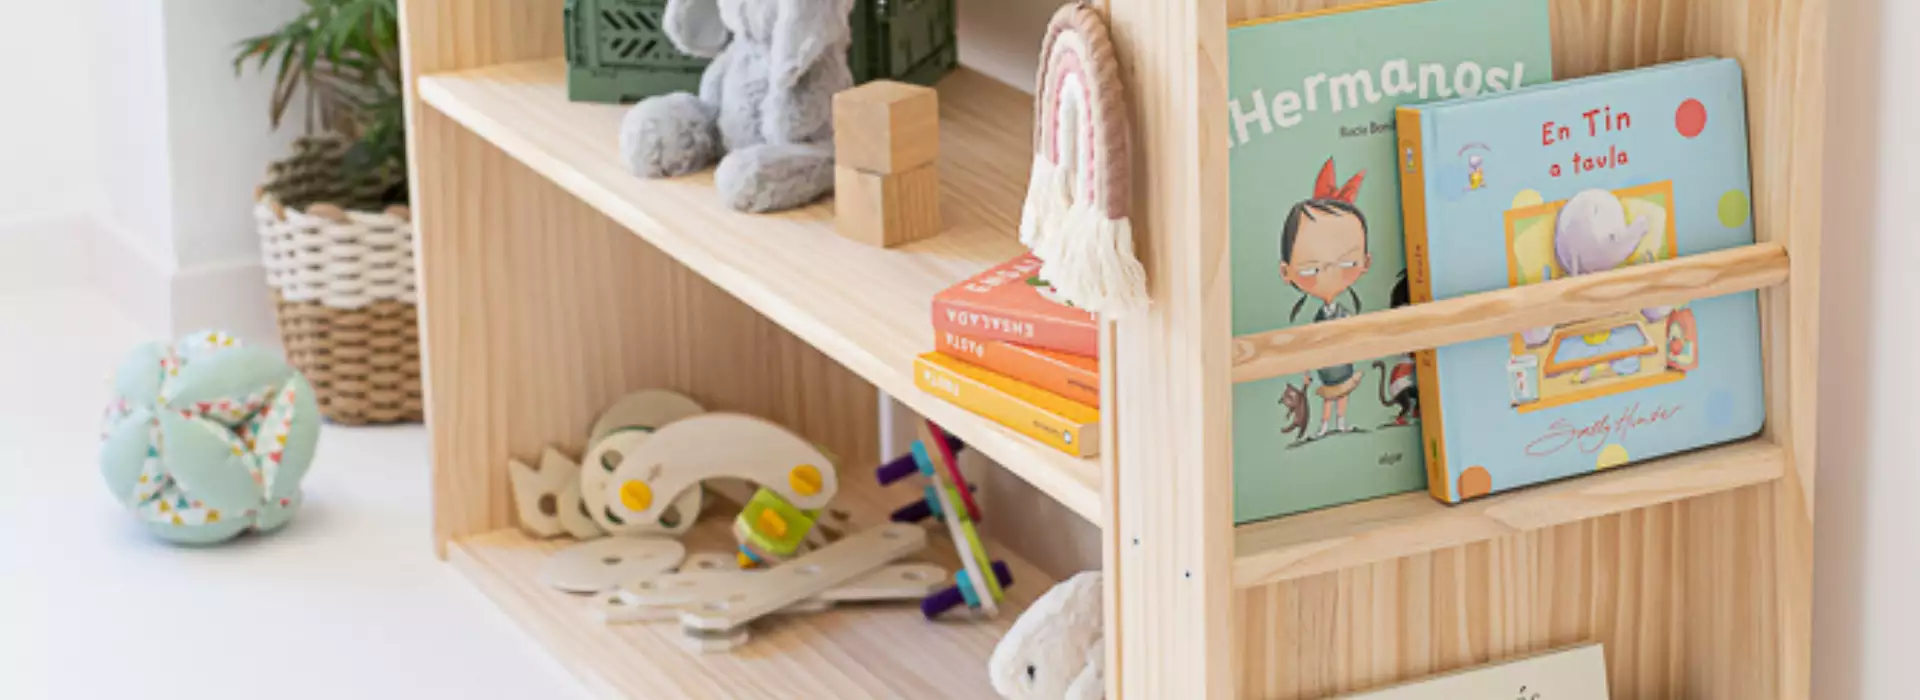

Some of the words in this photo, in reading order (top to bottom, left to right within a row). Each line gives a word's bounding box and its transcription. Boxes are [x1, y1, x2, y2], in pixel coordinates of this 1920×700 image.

[1228, 58, 1525, 149] Hermanos!
[1542, 121, 1570, 146] En
[1582, 104, 1631, 137] Tin
[1548, 163, 1562, 177] a
[1572, 144, 1629, 175] taula
[945, 308, 1035, 338] ENSALADA
[945, 331, 985, 358] PASTA
